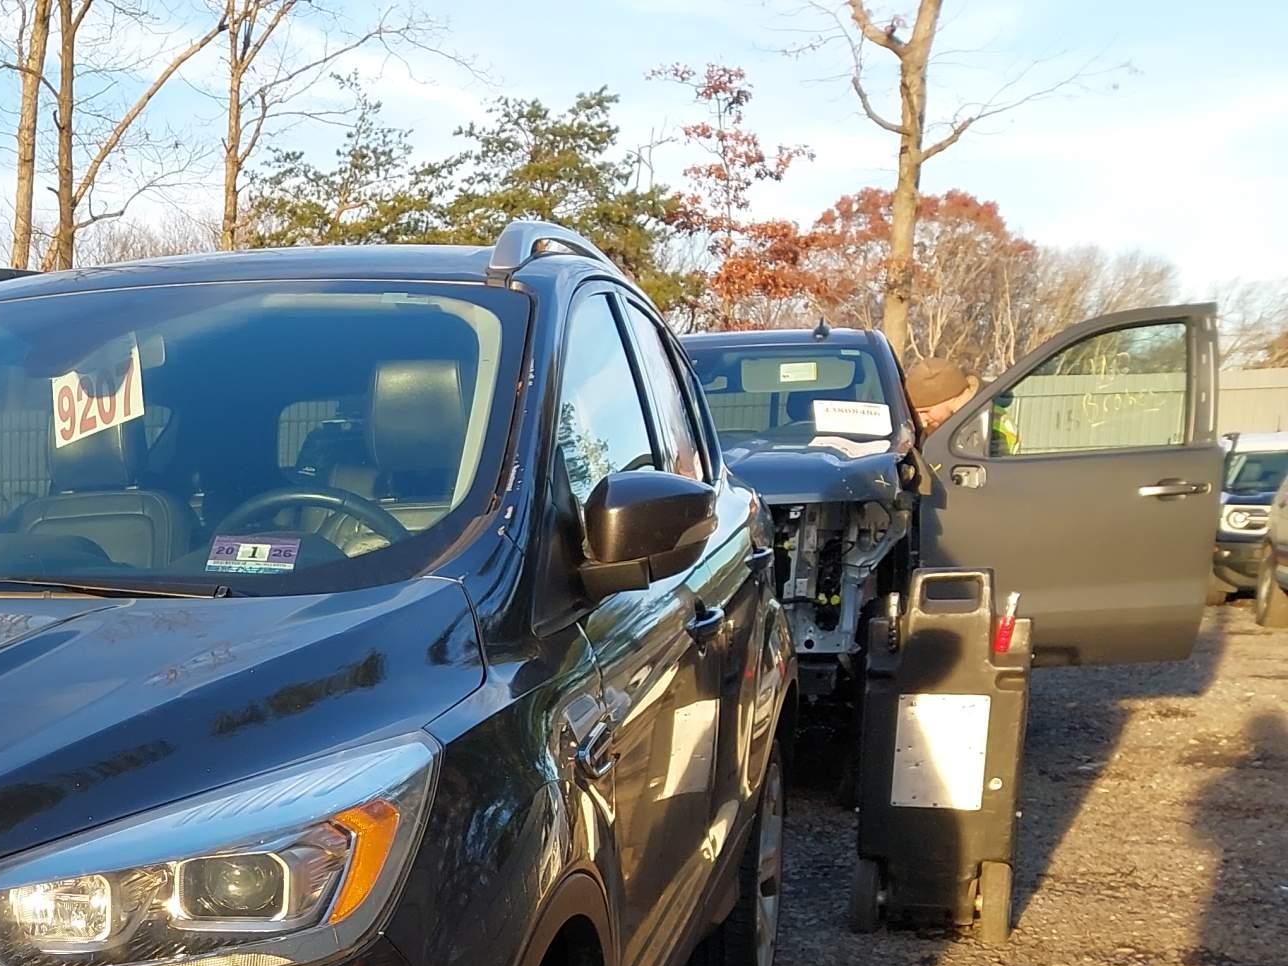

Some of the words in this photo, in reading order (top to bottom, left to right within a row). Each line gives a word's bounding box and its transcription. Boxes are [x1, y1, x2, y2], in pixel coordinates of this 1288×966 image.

[215, 546, 234, 555] 20
[248, 546, 259, 559] 1
[272, 549, 293, 558] 26
